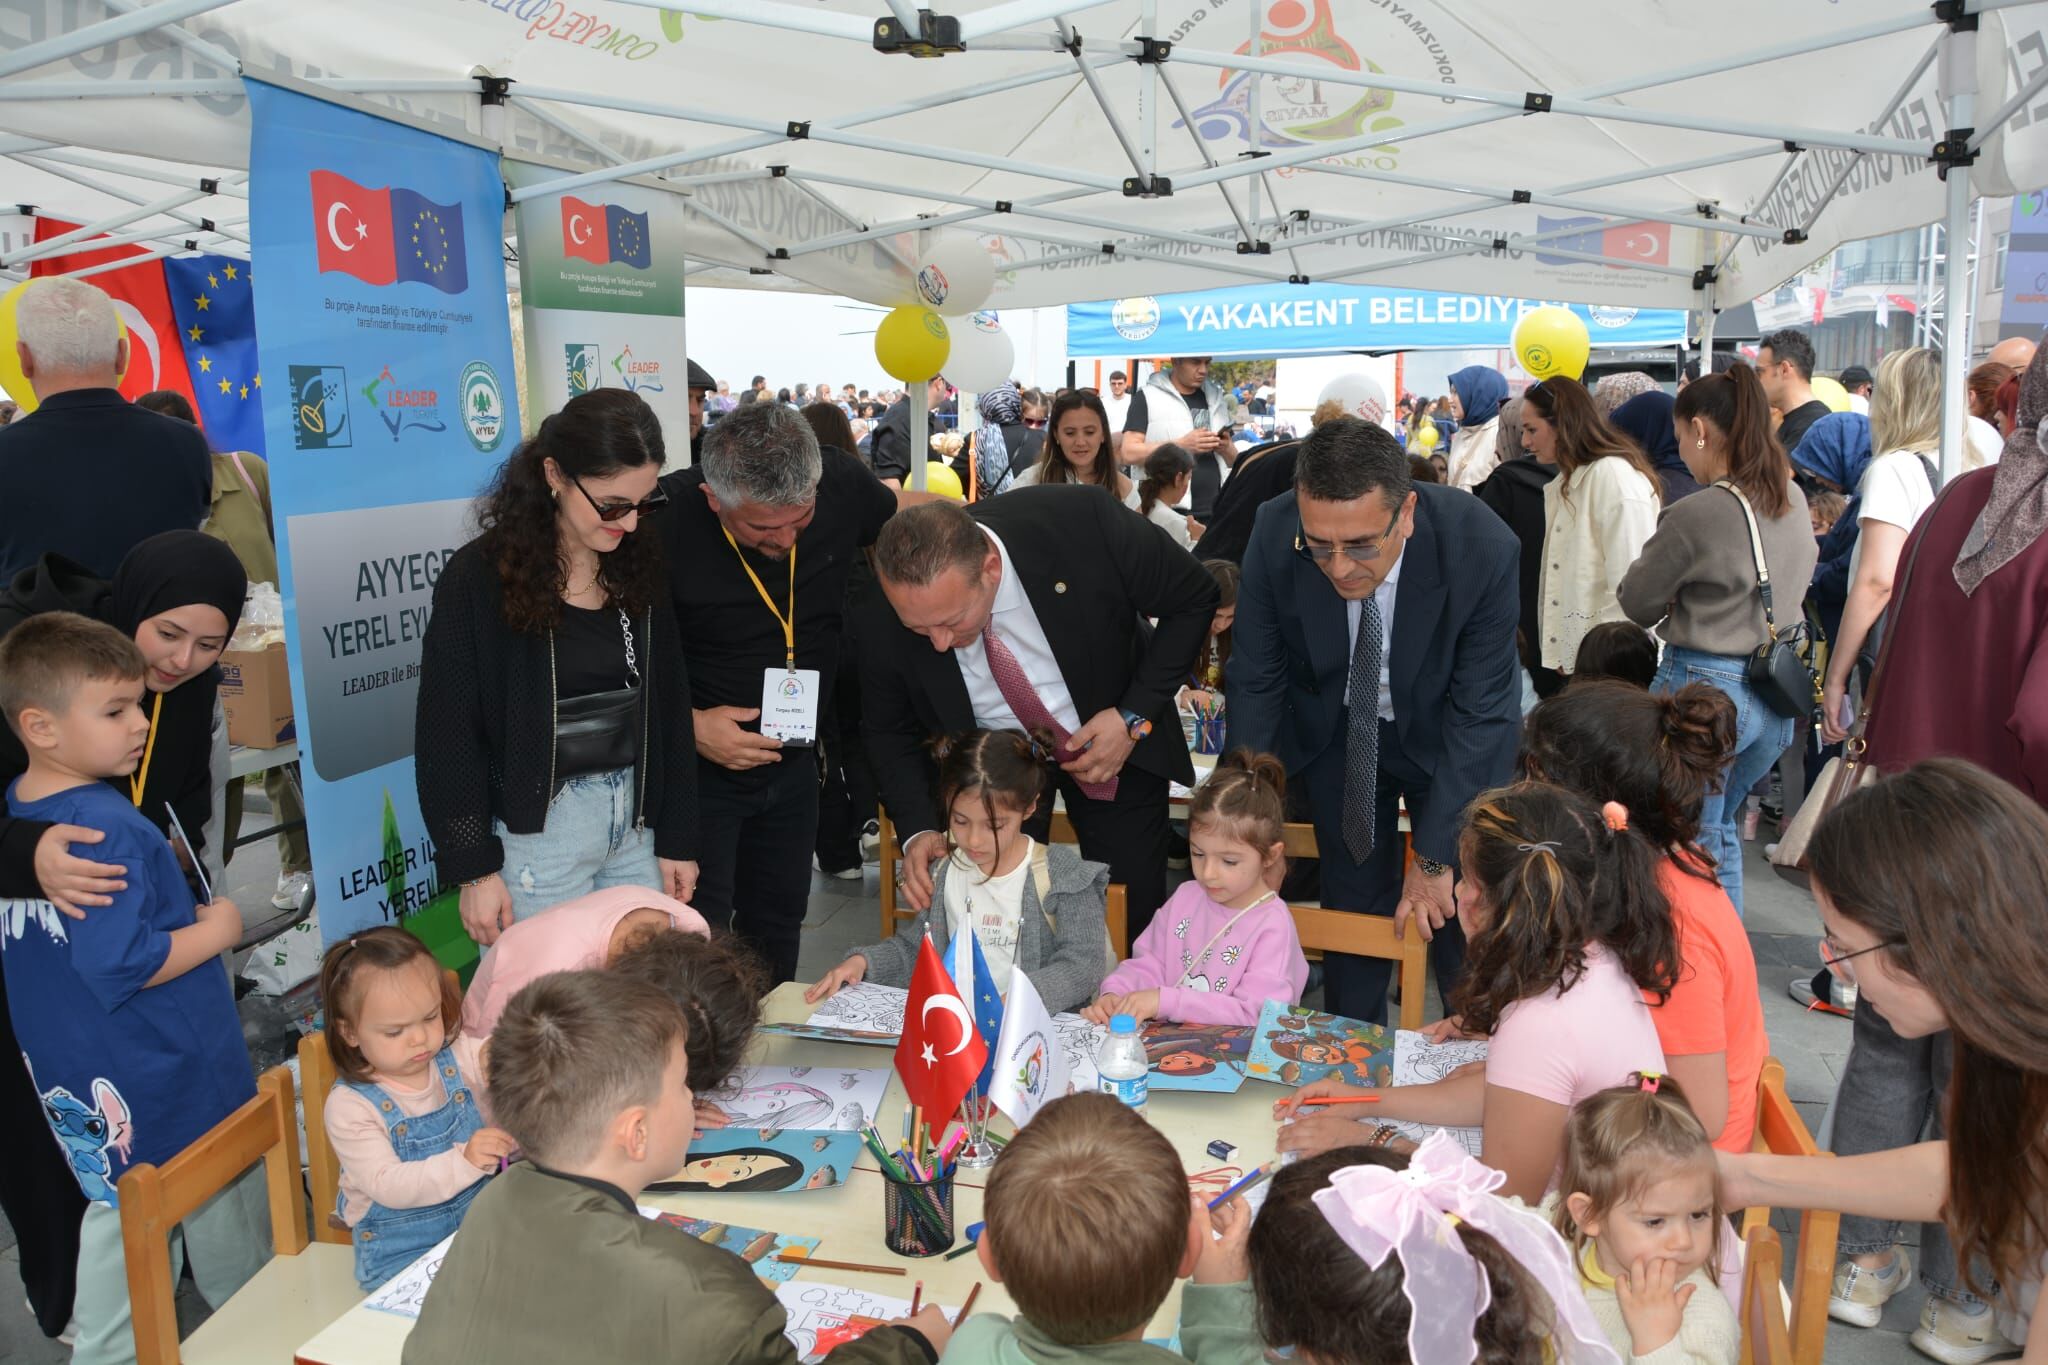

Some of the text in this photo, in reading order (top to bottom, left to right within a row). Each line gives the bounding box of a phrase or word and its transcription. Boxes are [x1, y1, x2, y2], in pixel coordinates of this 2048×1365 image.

[325, 298, 335, 310] Bu
[336, 302, 355, 313] proje
[356, 302, 380, 315] Avrupa
[1178, 298, 1360, 333] YAKAKENT
[627, 360, 660, 375] LEADER
[387, 391, 438, 409] LEADER
[322, 613, 396, 659] YEREL
[342, 669, 390, 696] LEADER
[391, 666, 404, 684] ile
[340, 847, 417, 901] LEADER
